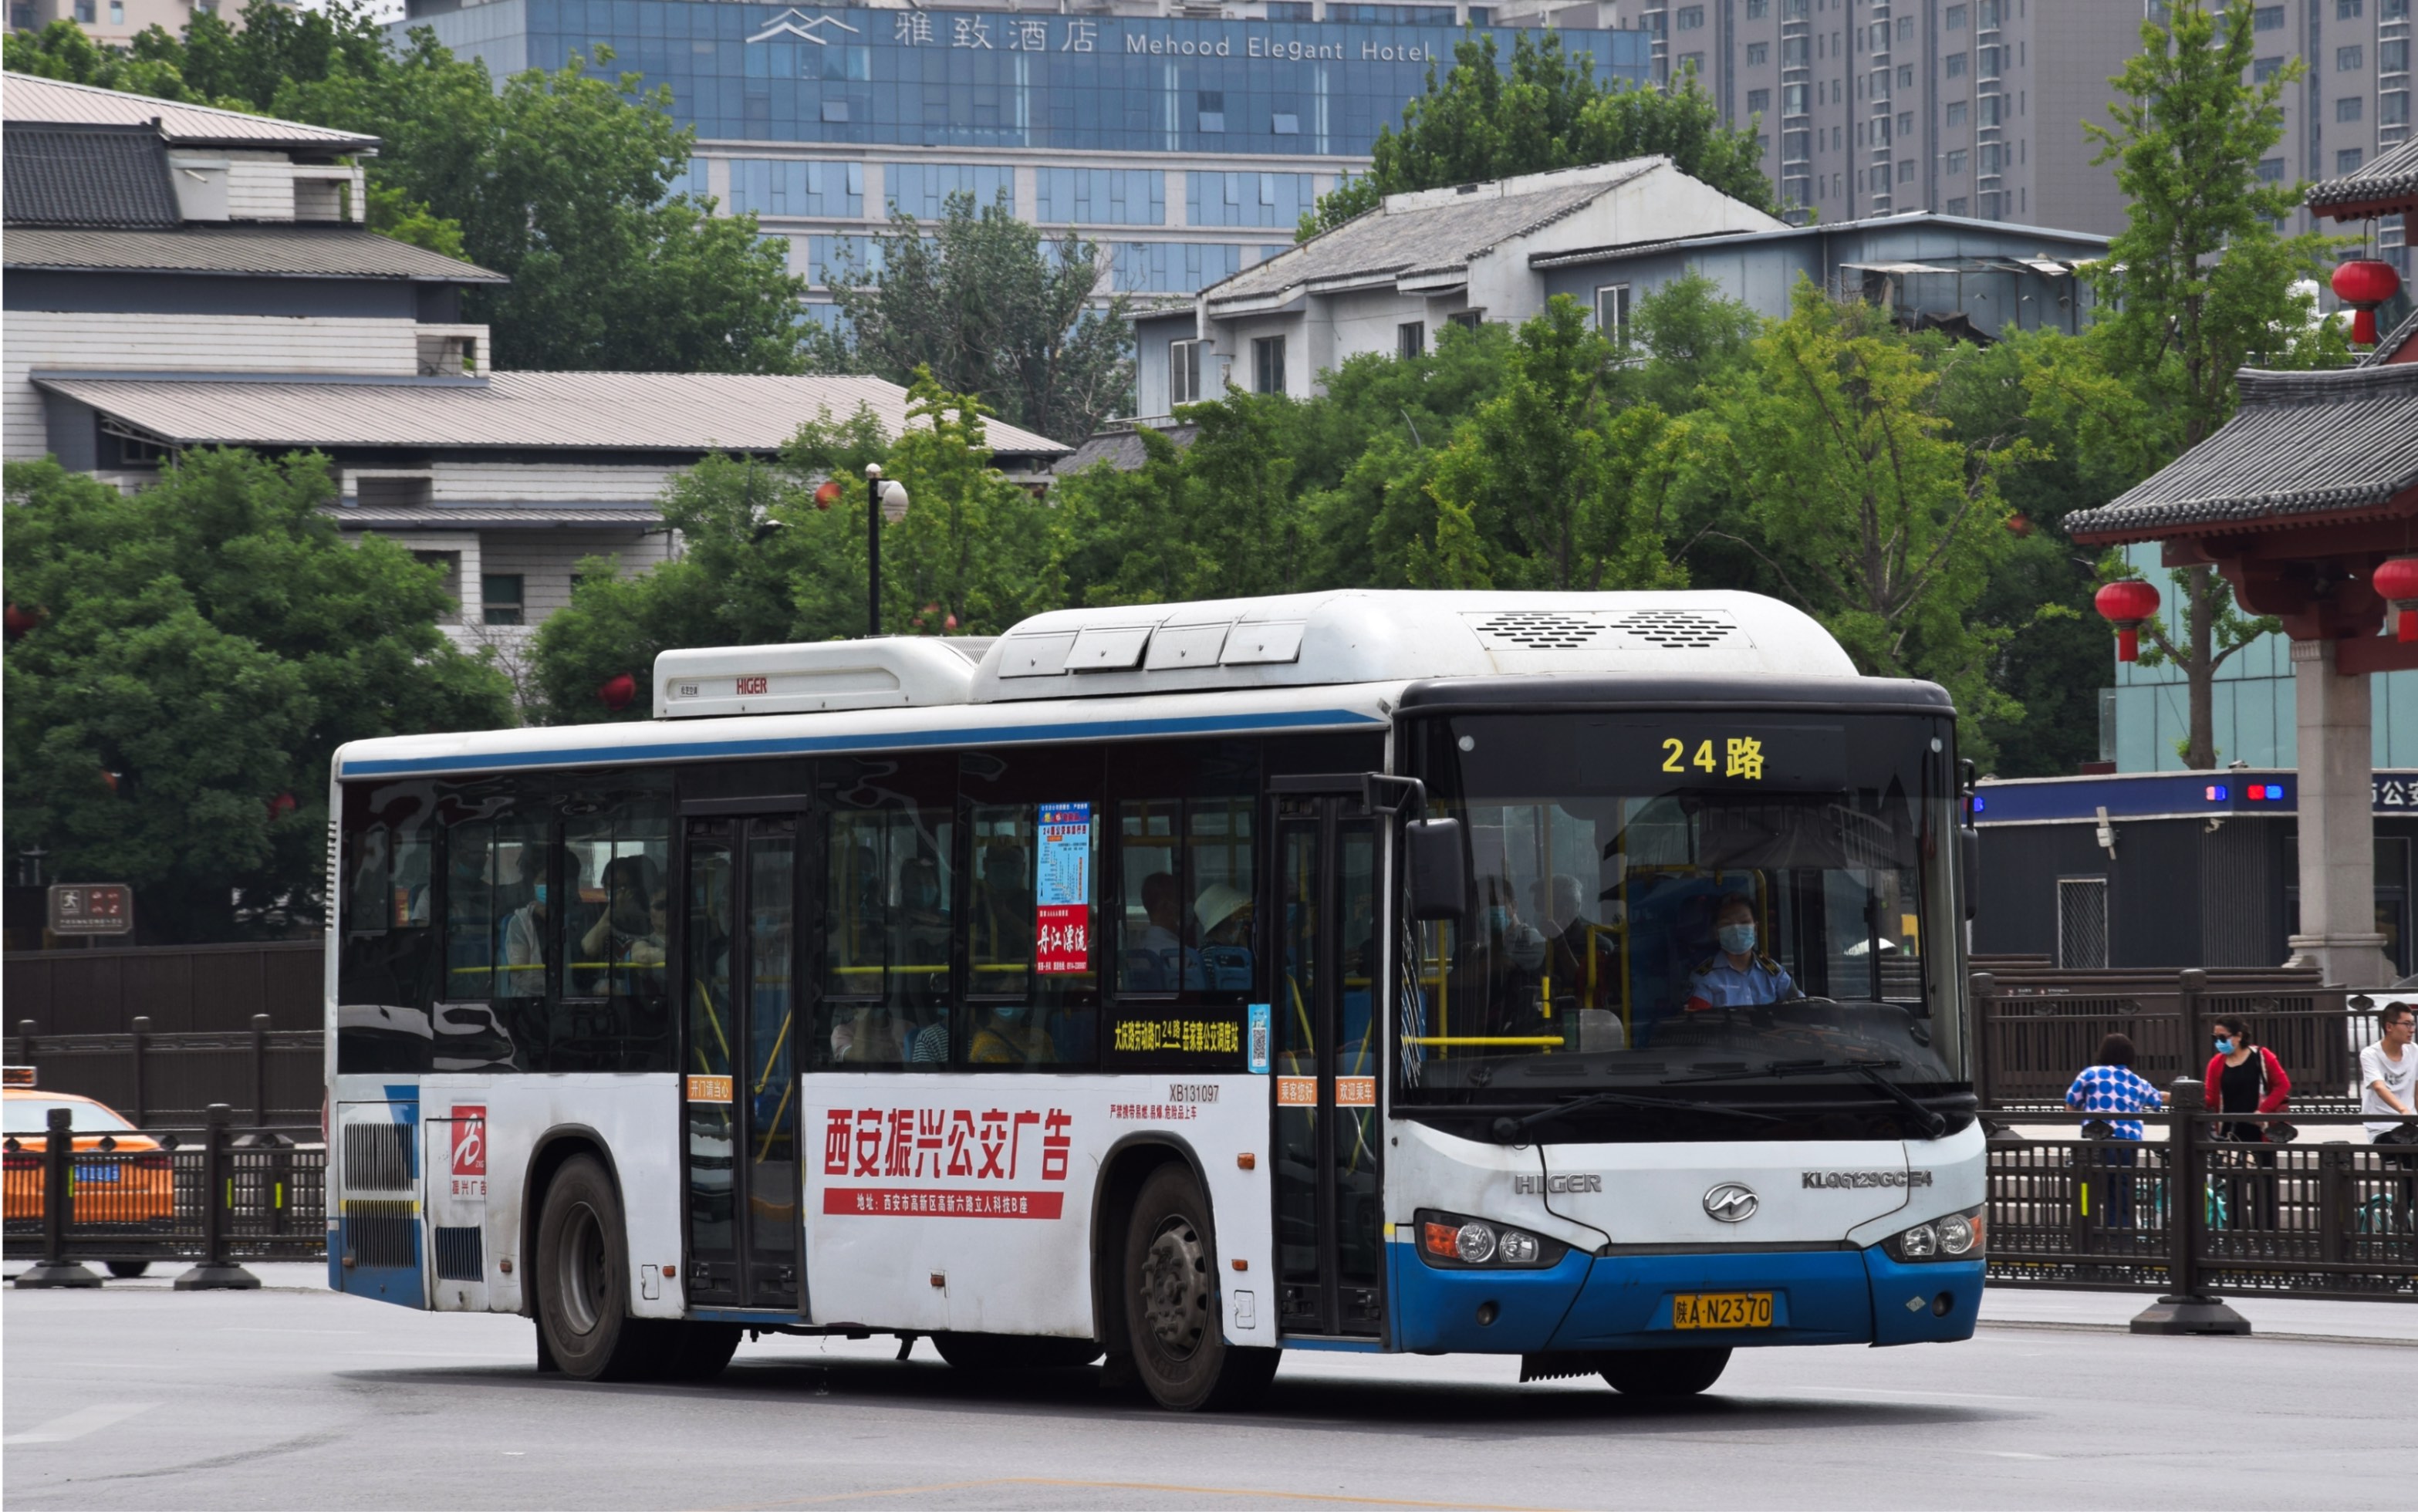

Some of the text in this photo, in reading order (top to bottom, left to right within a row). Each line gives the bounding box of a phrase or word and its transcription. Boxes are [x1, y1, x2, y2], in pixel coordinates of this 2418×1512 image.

[894, 10, 1098, 52] 雅致酒店
[1126, 33, 1430, 62] Mehood Elegant Hotel
[737, 677, 767, 694] HIGER
[1662, 736, 1765, 780] 24路
[1037, 923, 1087, 955] 丹江漂流
[1162, 1019, 1180, 1039] 24路
[691, 1080, 729, 1098] 开门请当心
[1169, 1084, 1219, 1102] XB131097
[1282, 1082, 1313, 1102] 乘客您好
[1339, 1082, 1372, 1102] 欢迎乘车
[824, 1108, 1072, 1181] 西安振兴公交广告
[452, 1180, 487, 1195] 振兴广告
[1515, 1173, 1602, 1194] HIGER
